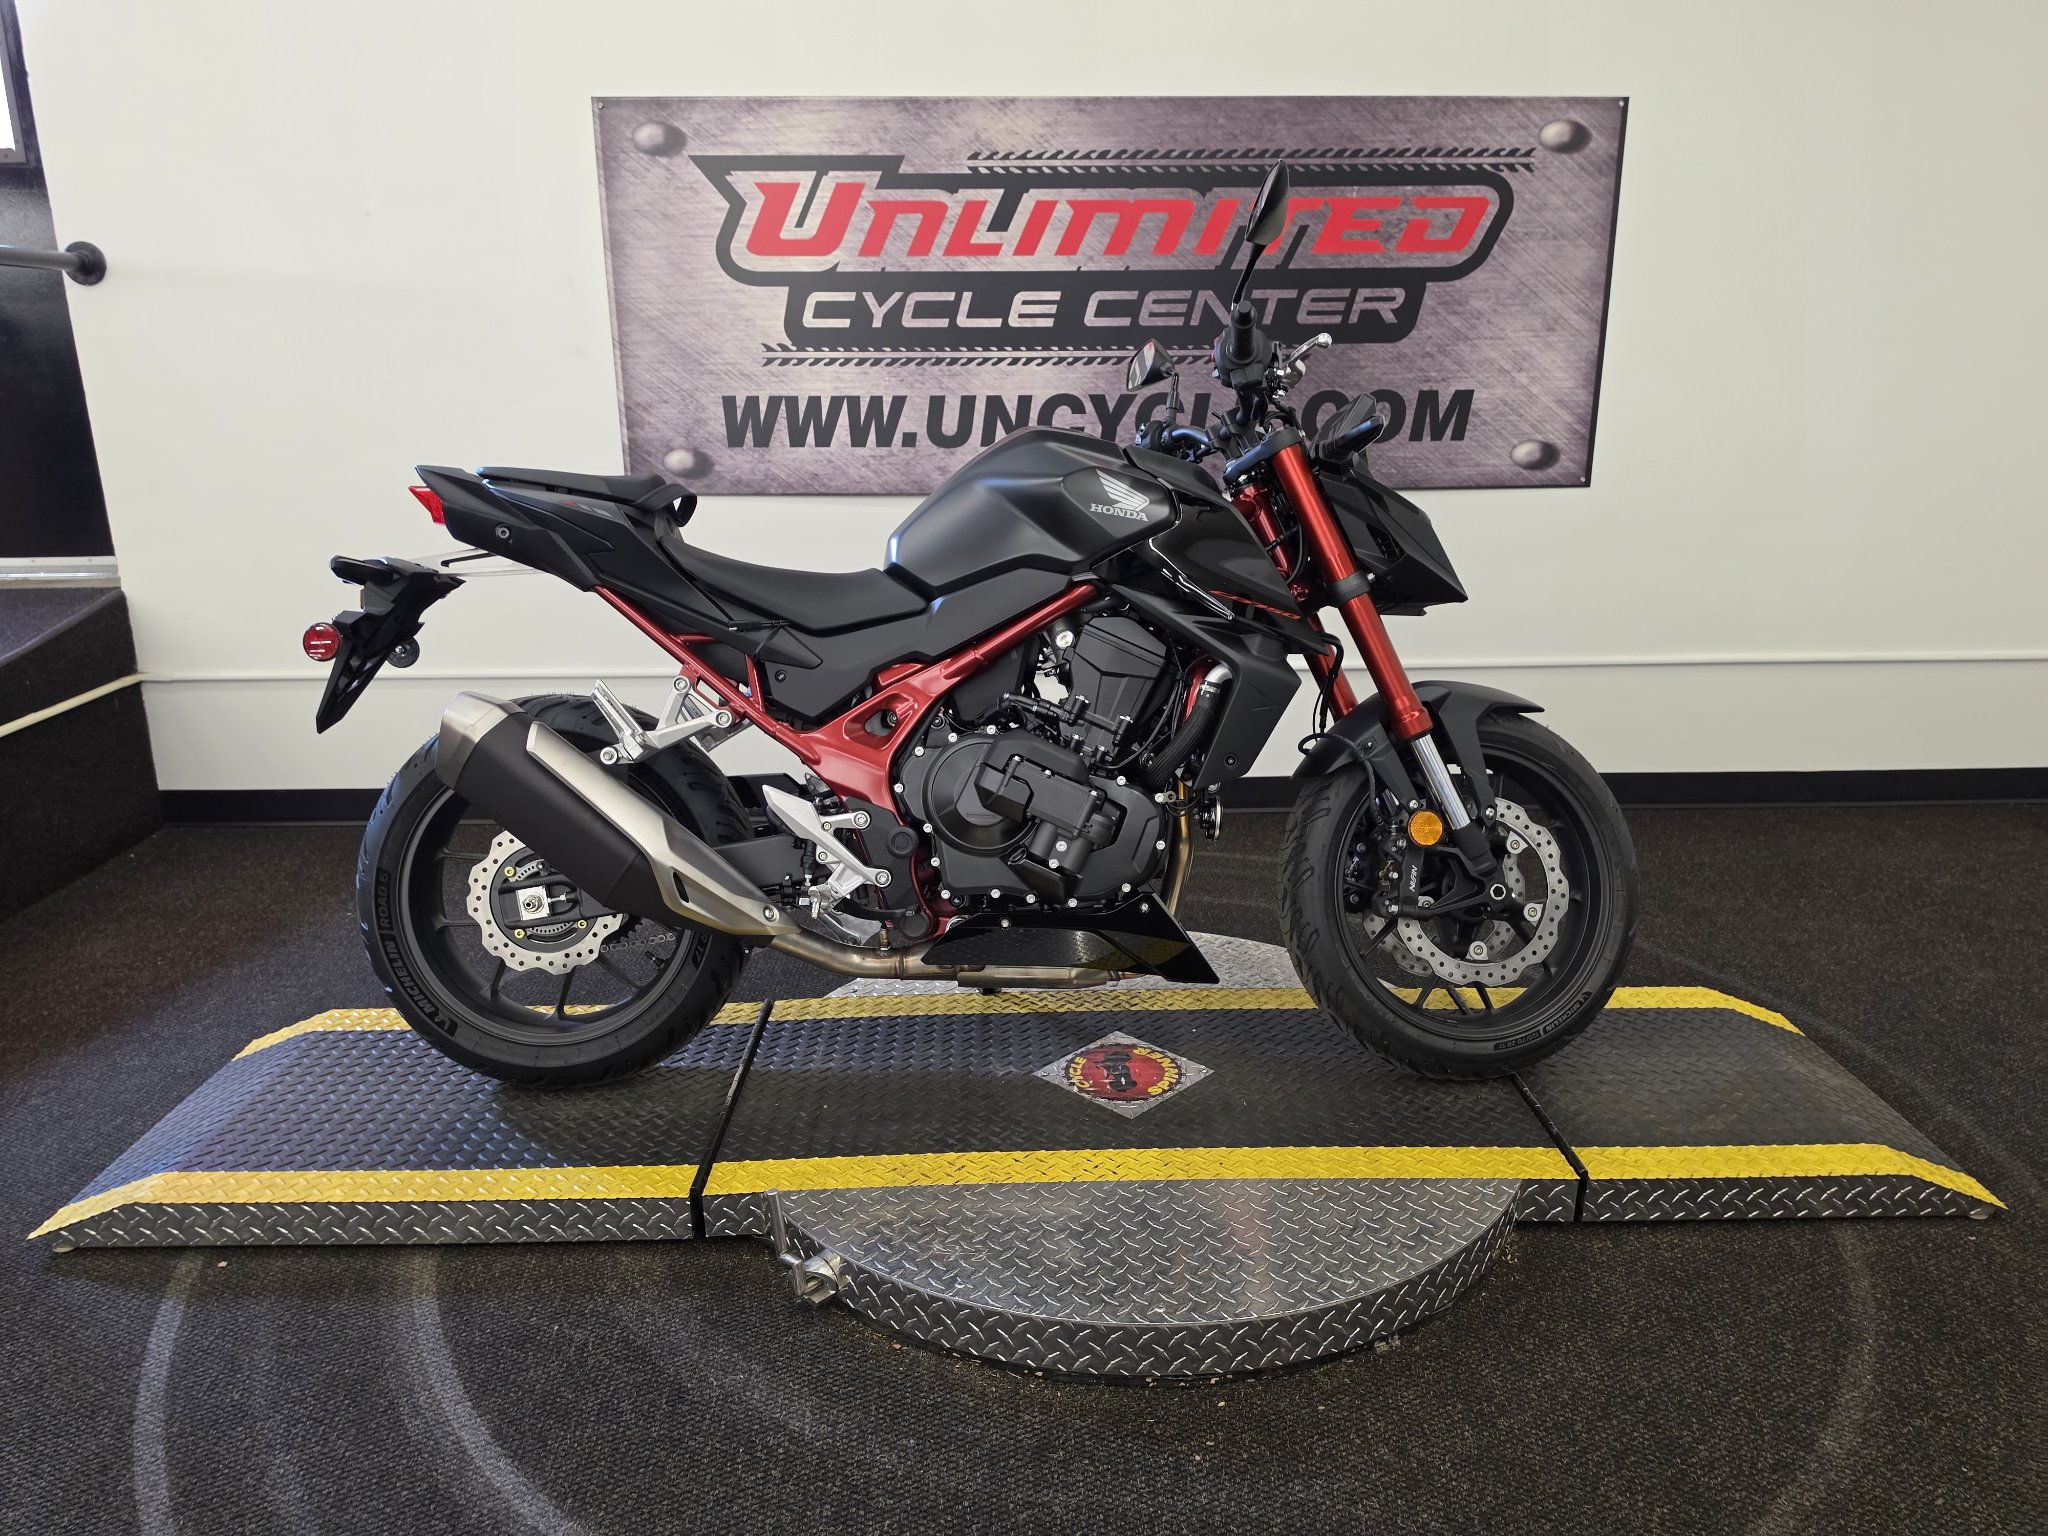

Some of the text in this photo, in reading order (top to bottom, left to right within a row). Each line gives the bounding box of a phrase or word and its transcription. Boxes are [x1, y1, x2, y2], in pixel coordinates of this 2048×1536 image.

[802, 287, 1407, 328] CYCLE CENTER
[721, 389, 1475, 448] WWW.UNCYCLCOM
[1090, 503, 1149, 521] HONDA
[378, 872, 437, 1014] MICHELIN ROAD 6
[1545, 1002, 1580, 1032] MICHELIN
[1069, 1056, 1090, 1088] CYCLE
[1132, 1047, 1179, 1096] SPINNER
